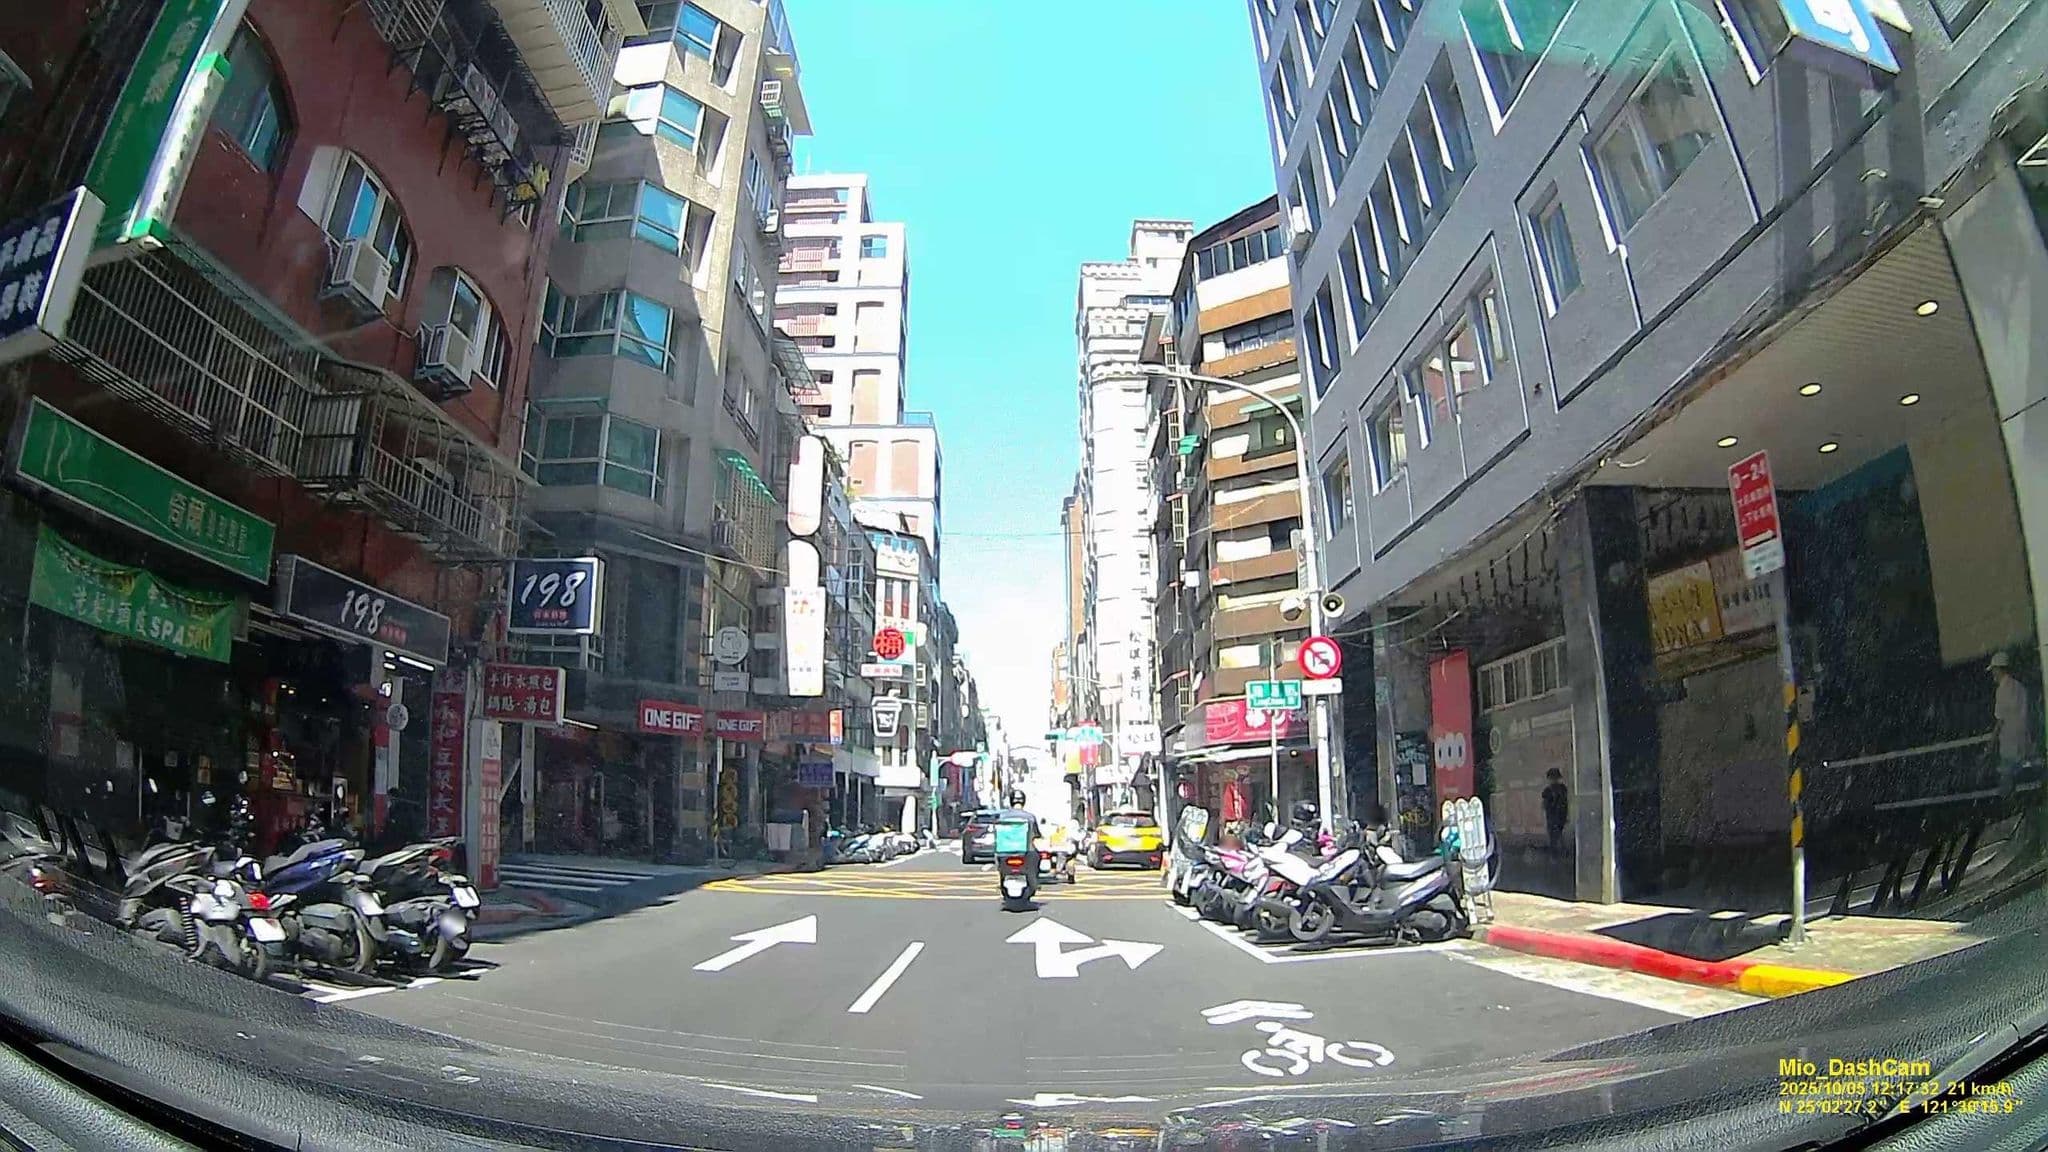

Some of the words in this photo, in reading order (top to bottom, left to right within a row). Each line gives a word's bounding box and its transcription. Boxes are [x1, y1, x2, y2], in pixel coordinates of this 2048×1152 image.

[520, 571, 586, 608] 198
[341, 590, 386, 636] 198
[150, 615, 185, 647] SPA
[644, 708, 671, 728] ONE
[717, 719, 738, 731] ONE
